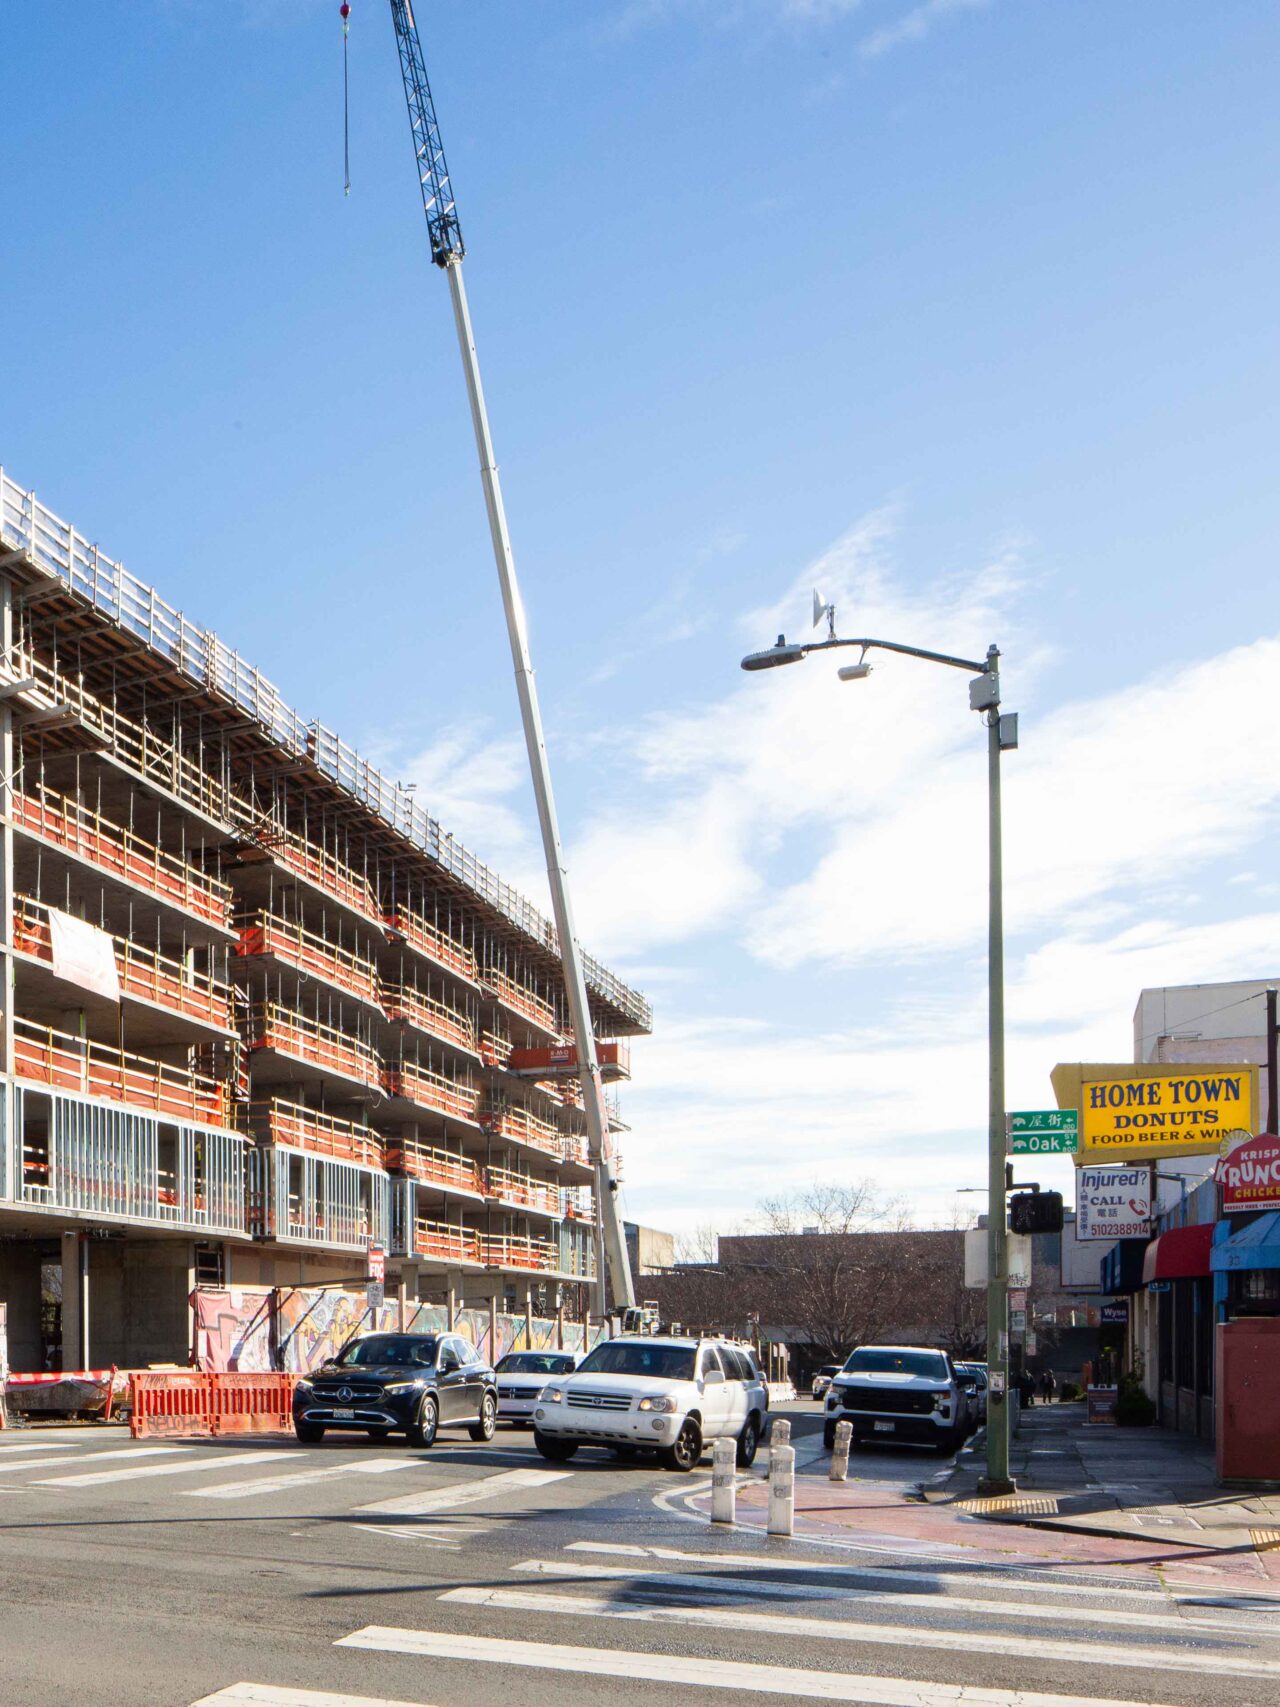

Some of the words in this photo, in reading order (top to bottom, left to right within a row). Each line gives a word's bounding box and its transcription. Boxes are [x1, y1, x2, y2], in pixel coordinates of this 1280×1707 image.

[1090, 1082, 1162, 1108] HOME
[1168, 1077, 1241, 1104] TOWN
[1114, 1110, 1219, 1129] DONUTS
[1029, 1136, 1060, 1151] Oak
[1092, 1134, 1134, 1144] FOOD
[1139, 1131, 1179, 1142] BEER
[1184, 1130, 1194, 1139] &
[1200, 1128, 1247, 1138] WIN
[1081, 1171, 1148, 1191] Injured?
[1090, 1196, 1125, 1206] CALL
[1097, 1208, 1118, 1217] 電話
[1091, 1223, 1148, 1236] 5102388914
